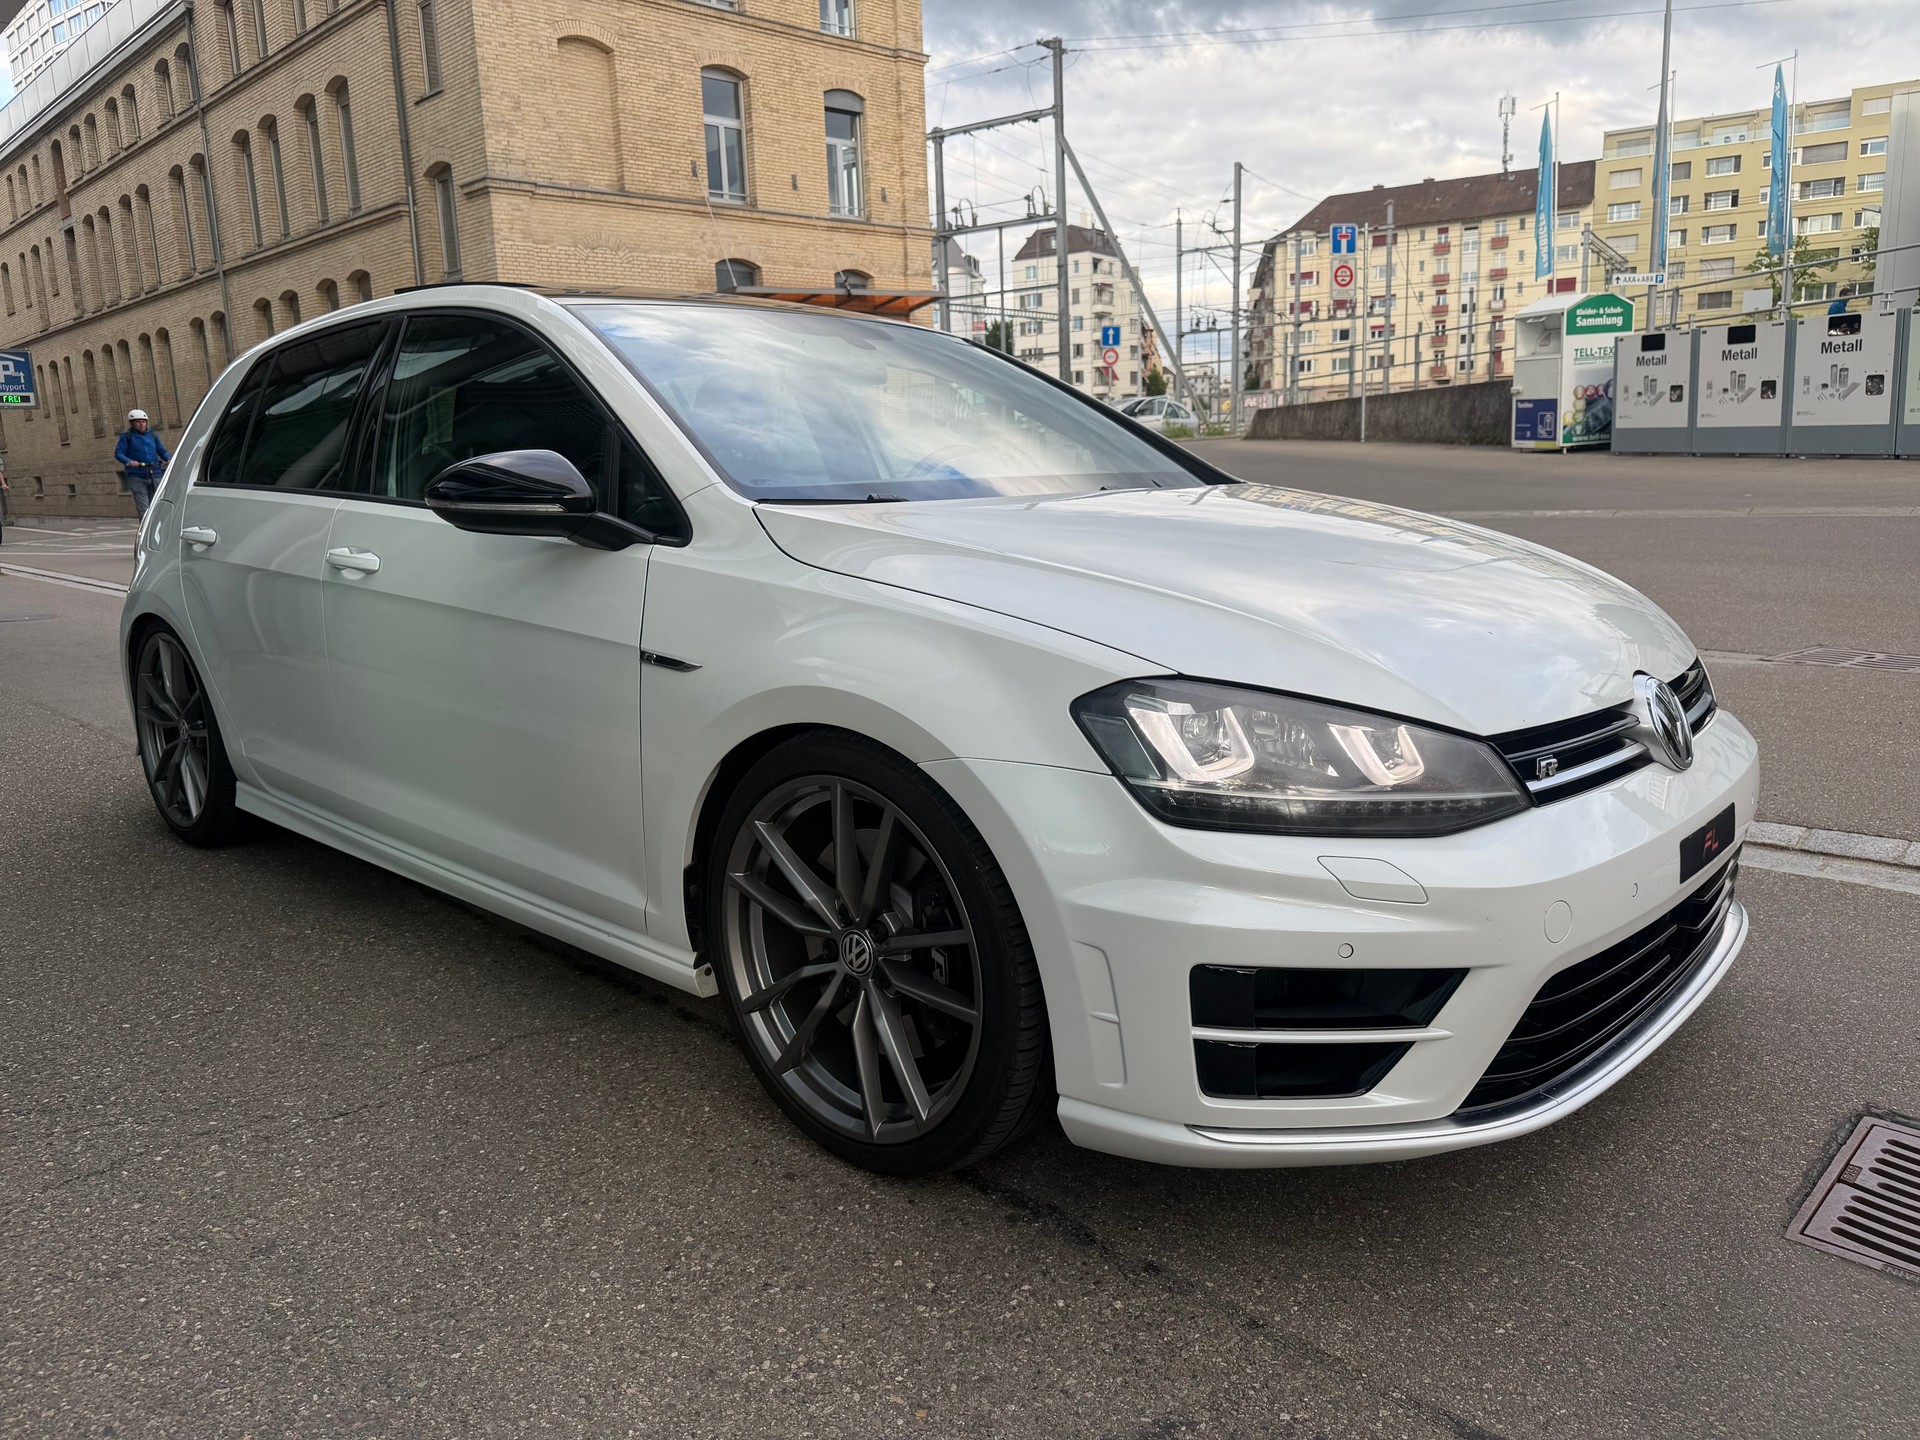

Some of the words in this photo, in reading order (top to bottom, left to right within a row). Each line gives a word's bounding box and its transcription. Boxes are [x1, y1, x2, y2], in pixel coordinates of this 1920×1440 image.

[1641, 275, 1654, 283] ABB
[1576, 307, 1598, 316] Kleider-
[1605, 305, 1624, 314] Schuh-
[1576, 315, 1623, 327] Sammlung
[1574, 346, 1615, 358] TELL-TEX
[1820, 339, 1863, 355] Metall
[1635, 354, 1667, 367] Metall
[1721, 347, 1758, 362] Metall
[3, 395, 21, 403] FREI
[1536, 754, 1558, 779] R
